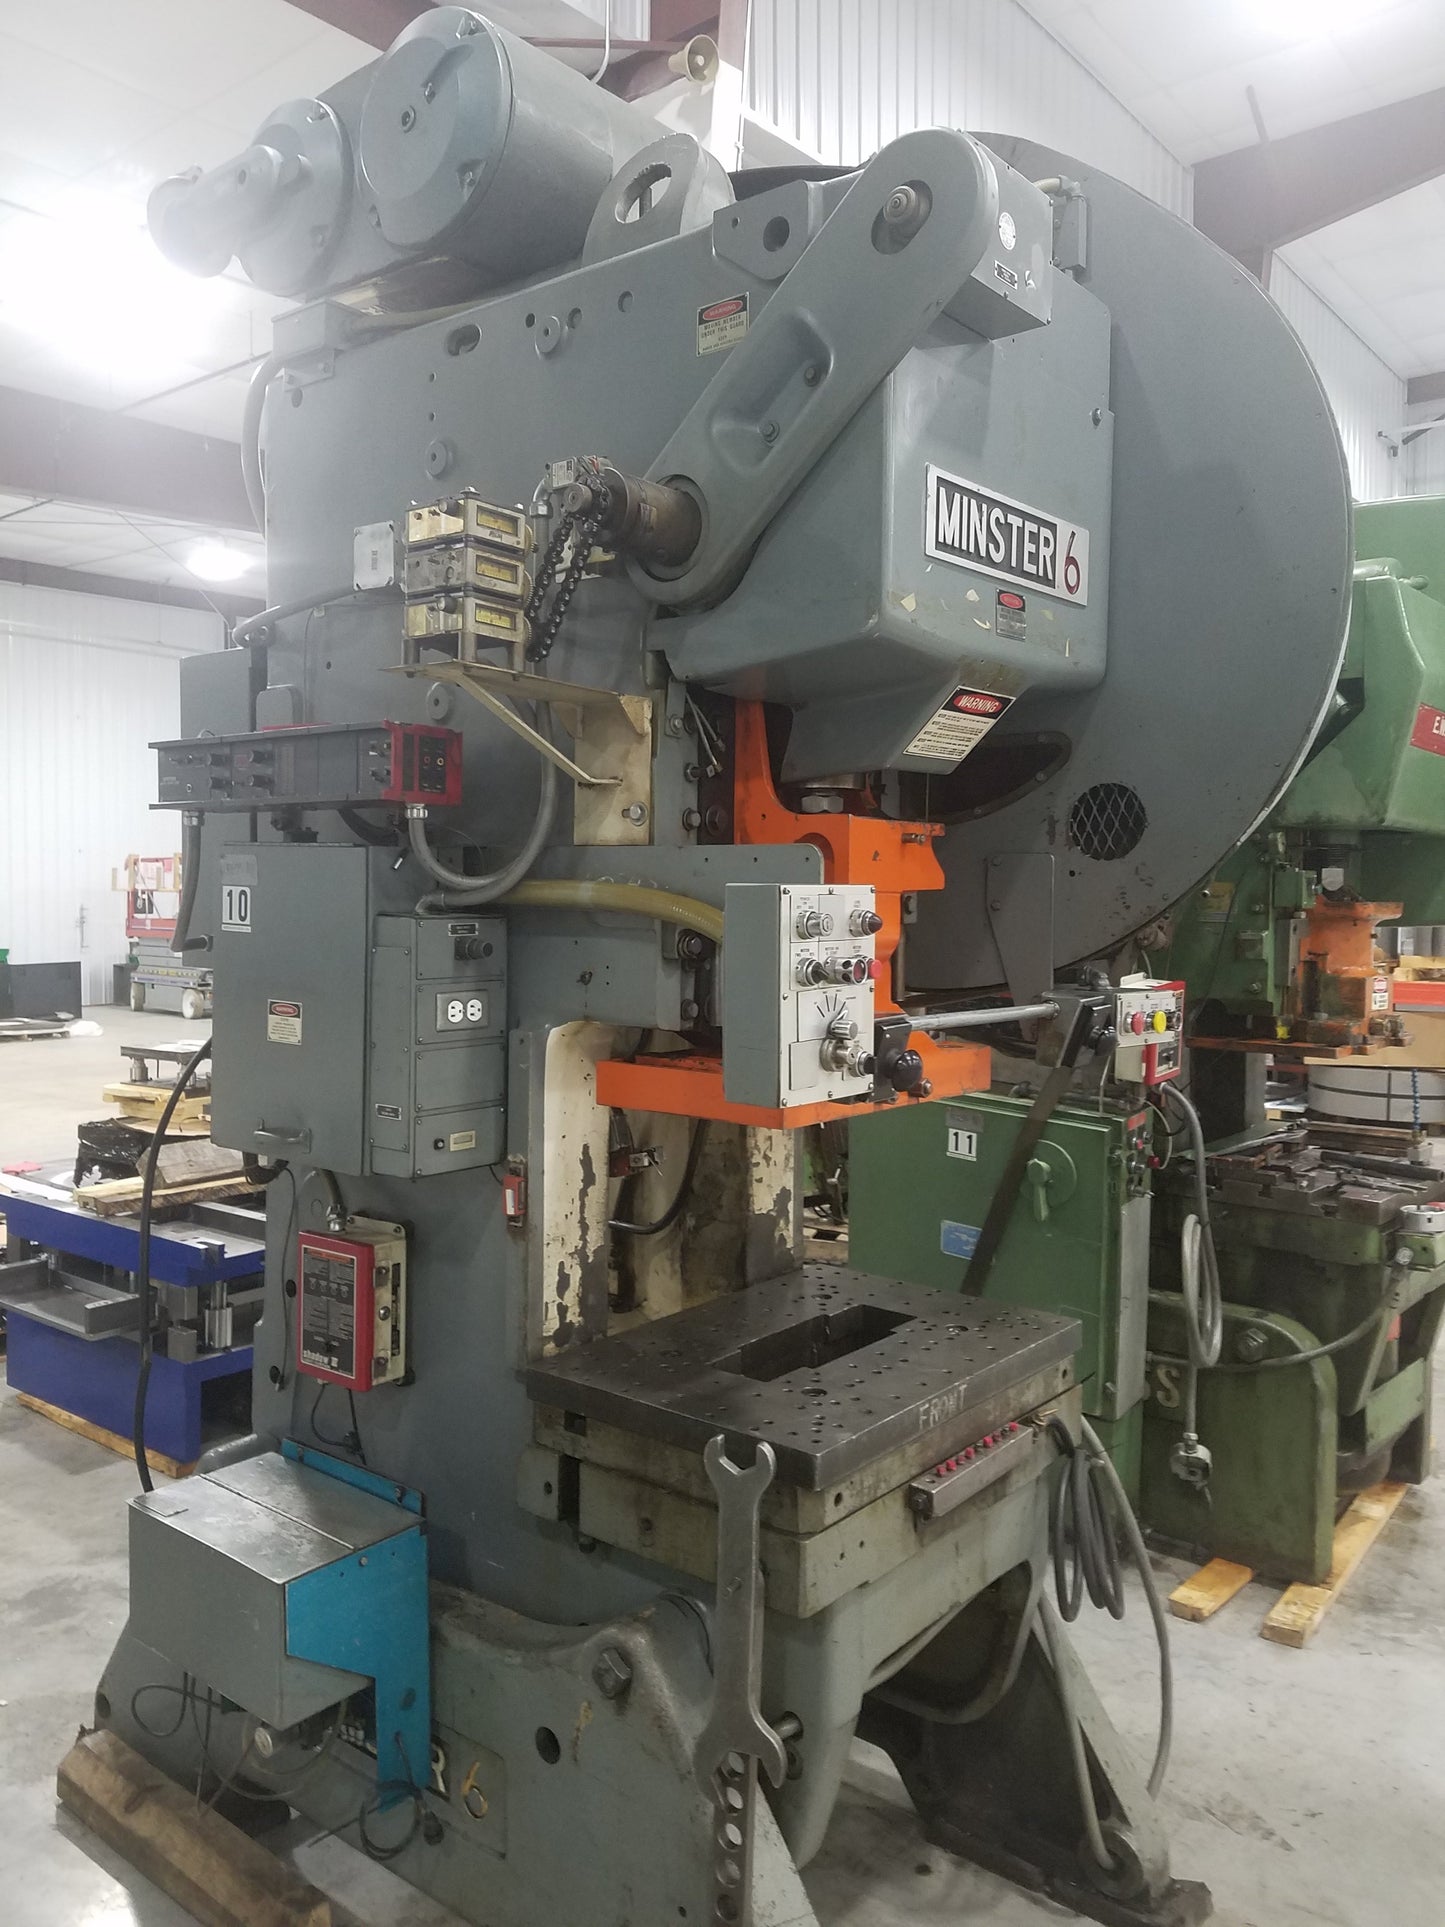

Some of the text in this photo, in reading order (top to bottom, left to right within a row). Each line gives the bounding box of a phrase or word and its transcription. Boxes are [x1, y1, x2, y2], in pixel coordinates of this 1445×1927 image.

[938, 486, 1081, 596] MINSTER 6
[958, 695, 999, 713] WARNING
[226, 889, 248, 922] 10
[952, 1131, 973, 1155] 11
[919, 1384, 968, 1430] FRONT
